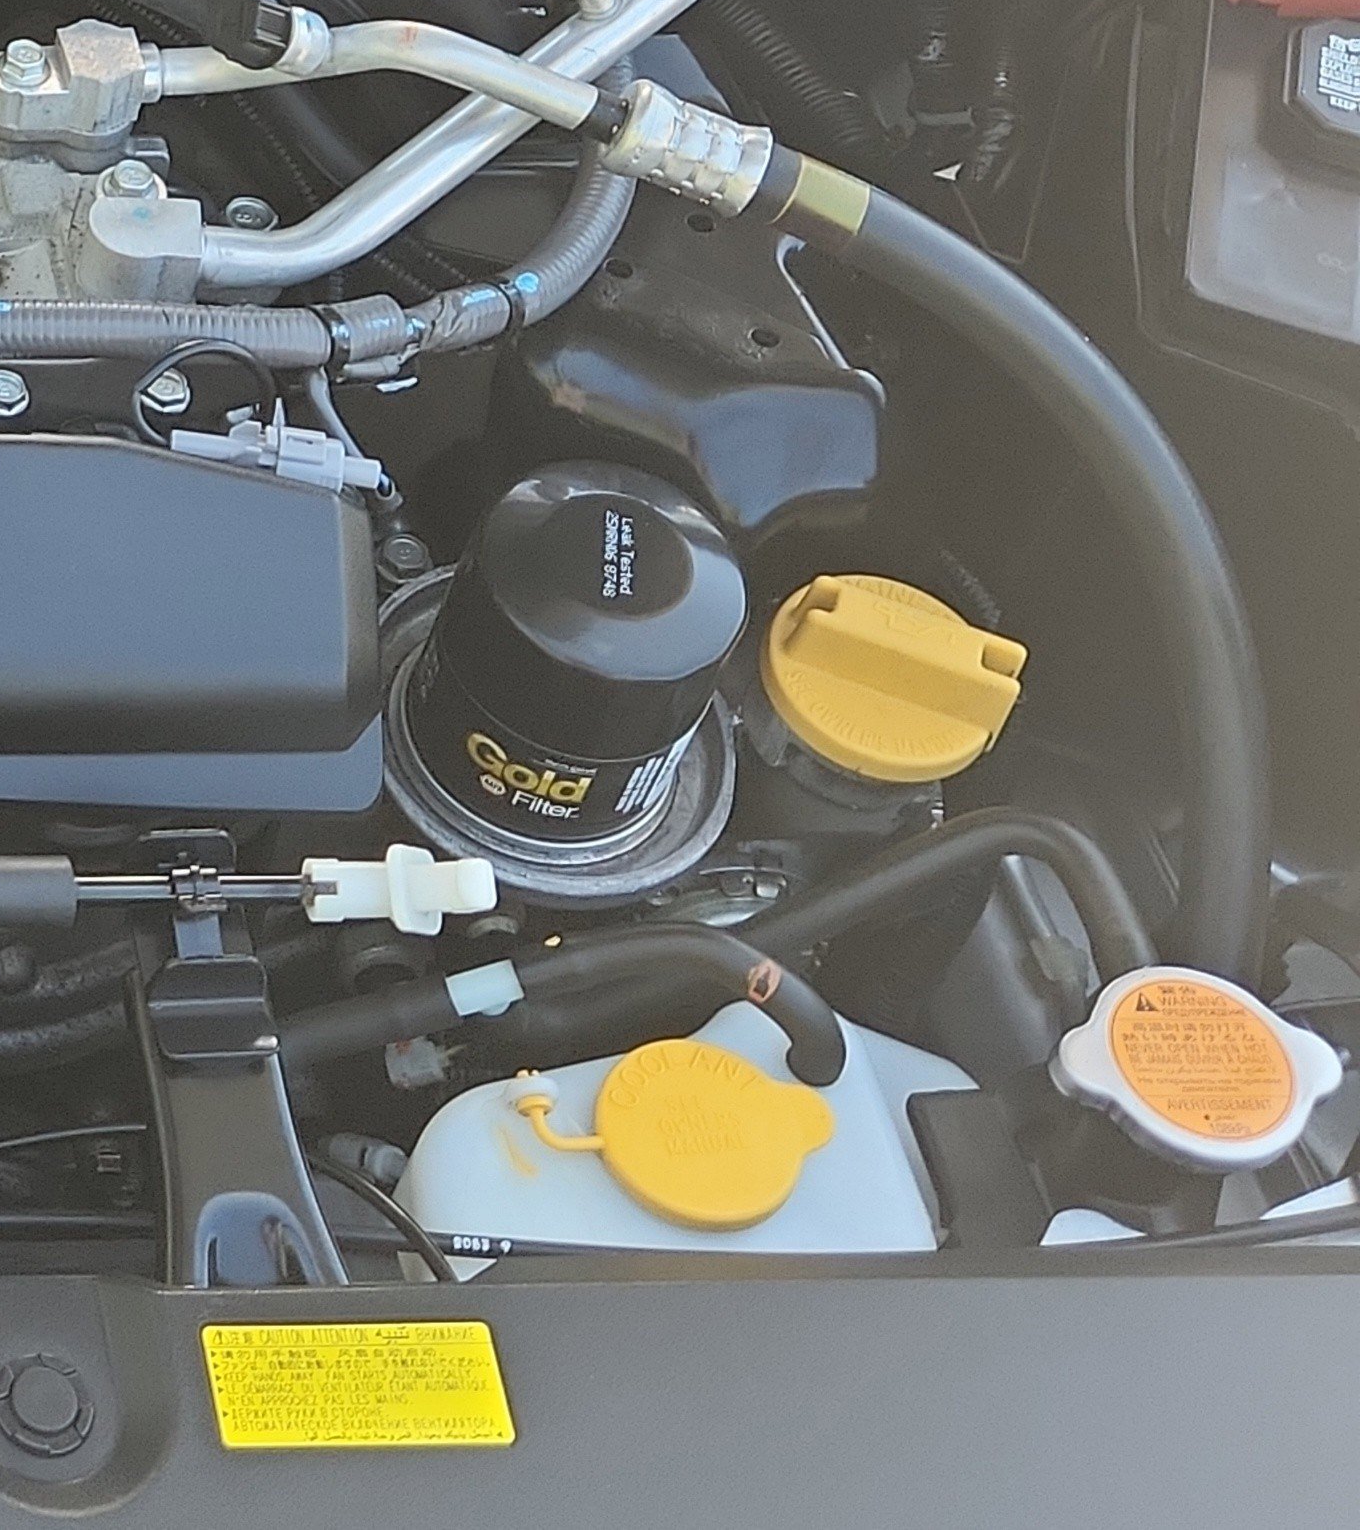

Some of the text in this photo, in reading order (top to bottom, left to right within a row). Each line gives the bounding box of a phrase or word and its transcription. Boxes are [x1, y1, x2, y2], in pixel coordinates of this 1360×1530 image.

[620, 550, 636, 596] Tested
[467, 732, 593, 804] Gold
[511, 789, 581, 819] Filter
[1160, 995, 1228, 1007] WARNING
[1124, 1043, 1164, 1053] NEVER
[1167, 1043, 1201, 1054] OPEN
[1205, 1043, 1241, 1054] WHEN
[1145, 1053, 1183, 1065] JAMAIS
[1185, 1053, 1223, 1065] OUVRIR
[609, 1045, 767, 1108] COOLANT
[1167, 1098, 1272, 1111] AVERTISSEMENT
[259, 1329, 306, 1345] CAUTION
[311, 1328, 369, 1344] ATTENTION
[415, 1326, 478, 1341] ВНИМАНИЕ
[224, 1372, 247, 1382] KEEP
[253, 1372, 285, 1382] HANDS
[325, 1371, 346, 1381] FAN
[349, 1370, 387, 1381] STARTS
[321, 1381, 384, 1393] VENTILATEUR
[323, 1394, 345, 1405] PAS
[349, 1393, 370, 1404] LES
